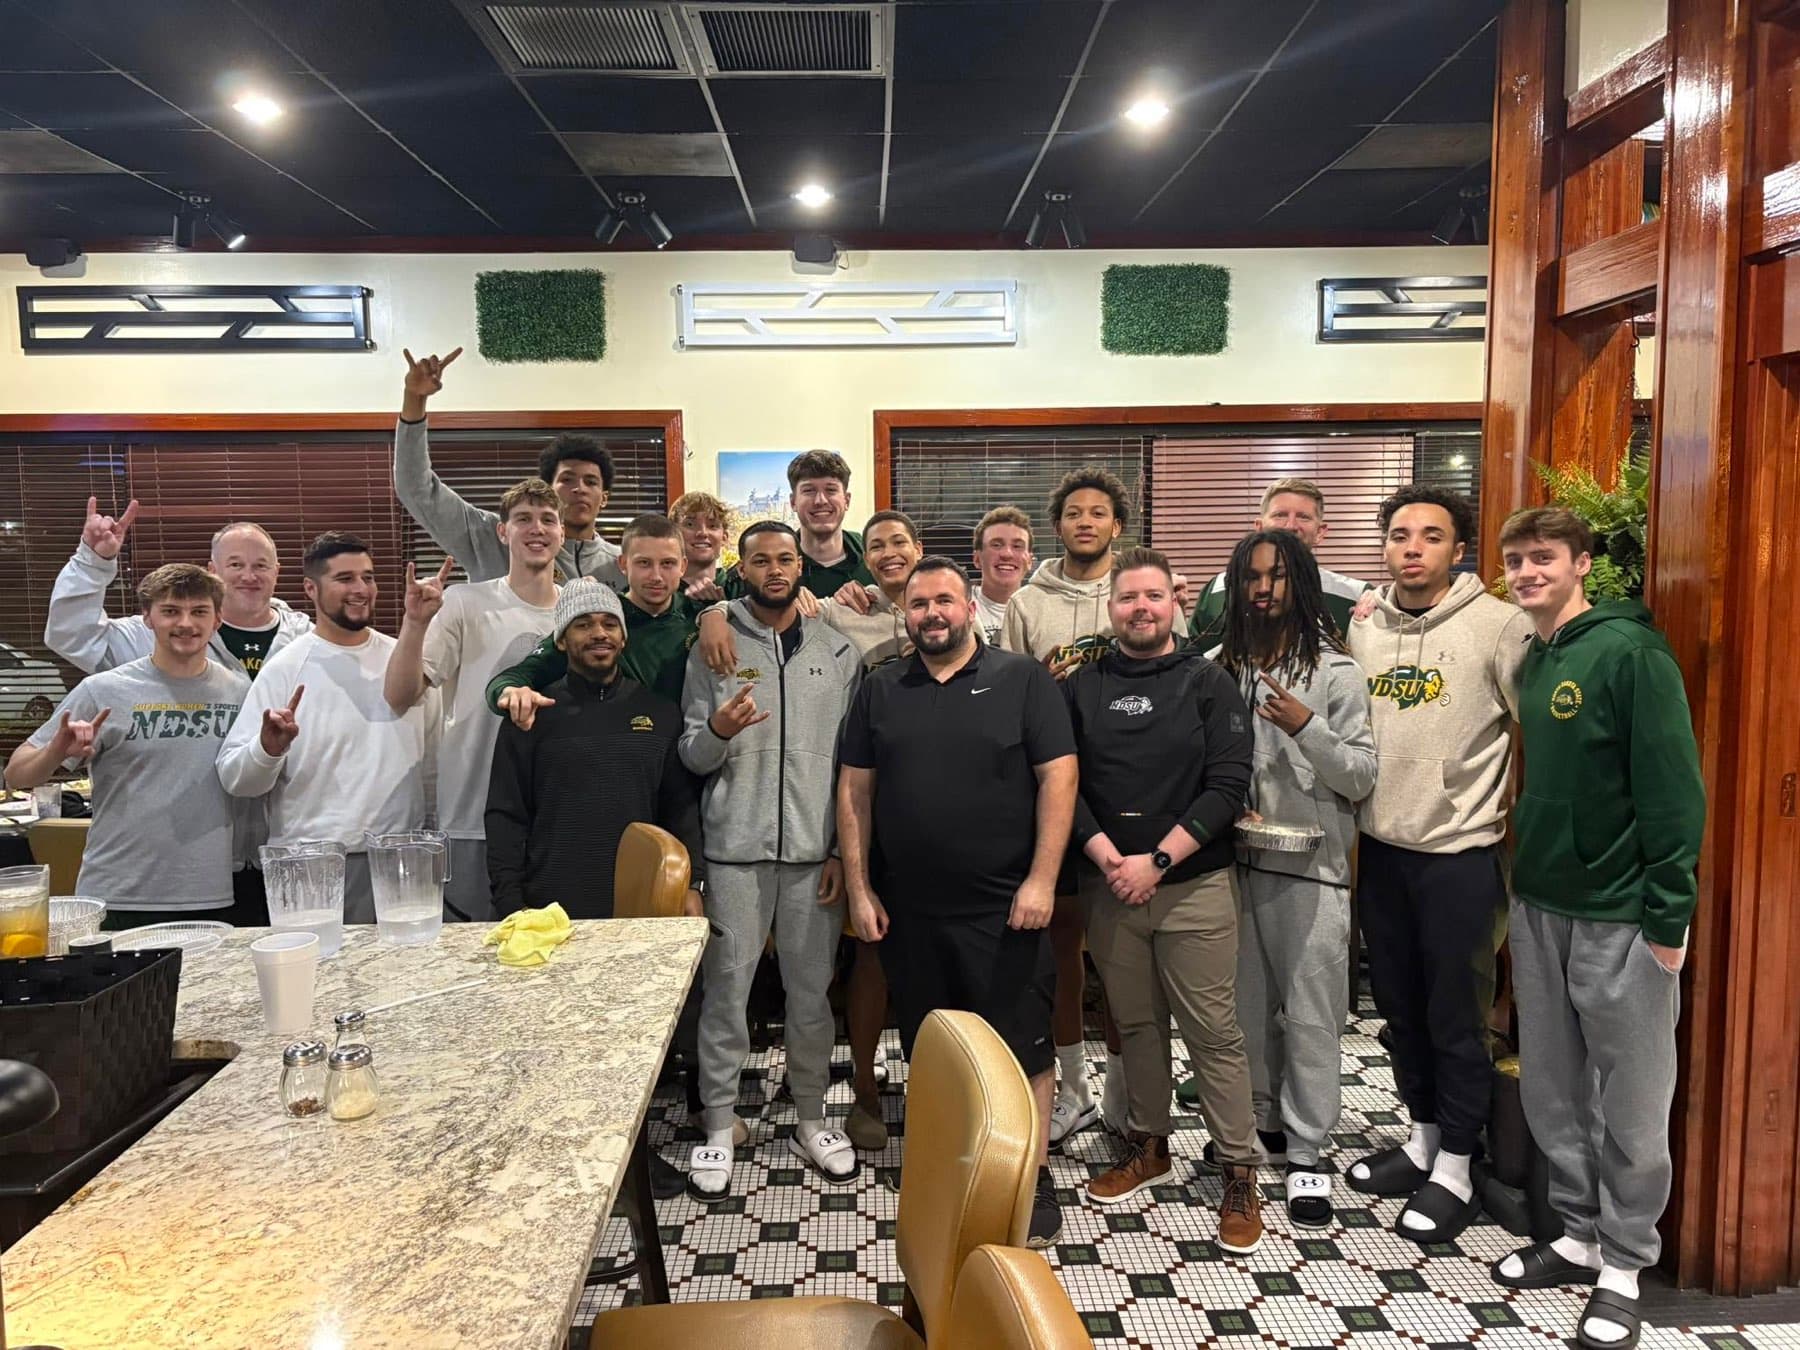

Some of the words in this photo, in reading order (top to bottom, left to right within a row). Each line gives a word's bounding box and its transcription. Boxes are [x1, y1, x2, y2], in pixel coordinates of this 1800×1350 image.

[1367, 676, 1425, 700] NDSU
[213, 703, 239, 711] SPORTS
[125, 710, 240, 741] NDSU
